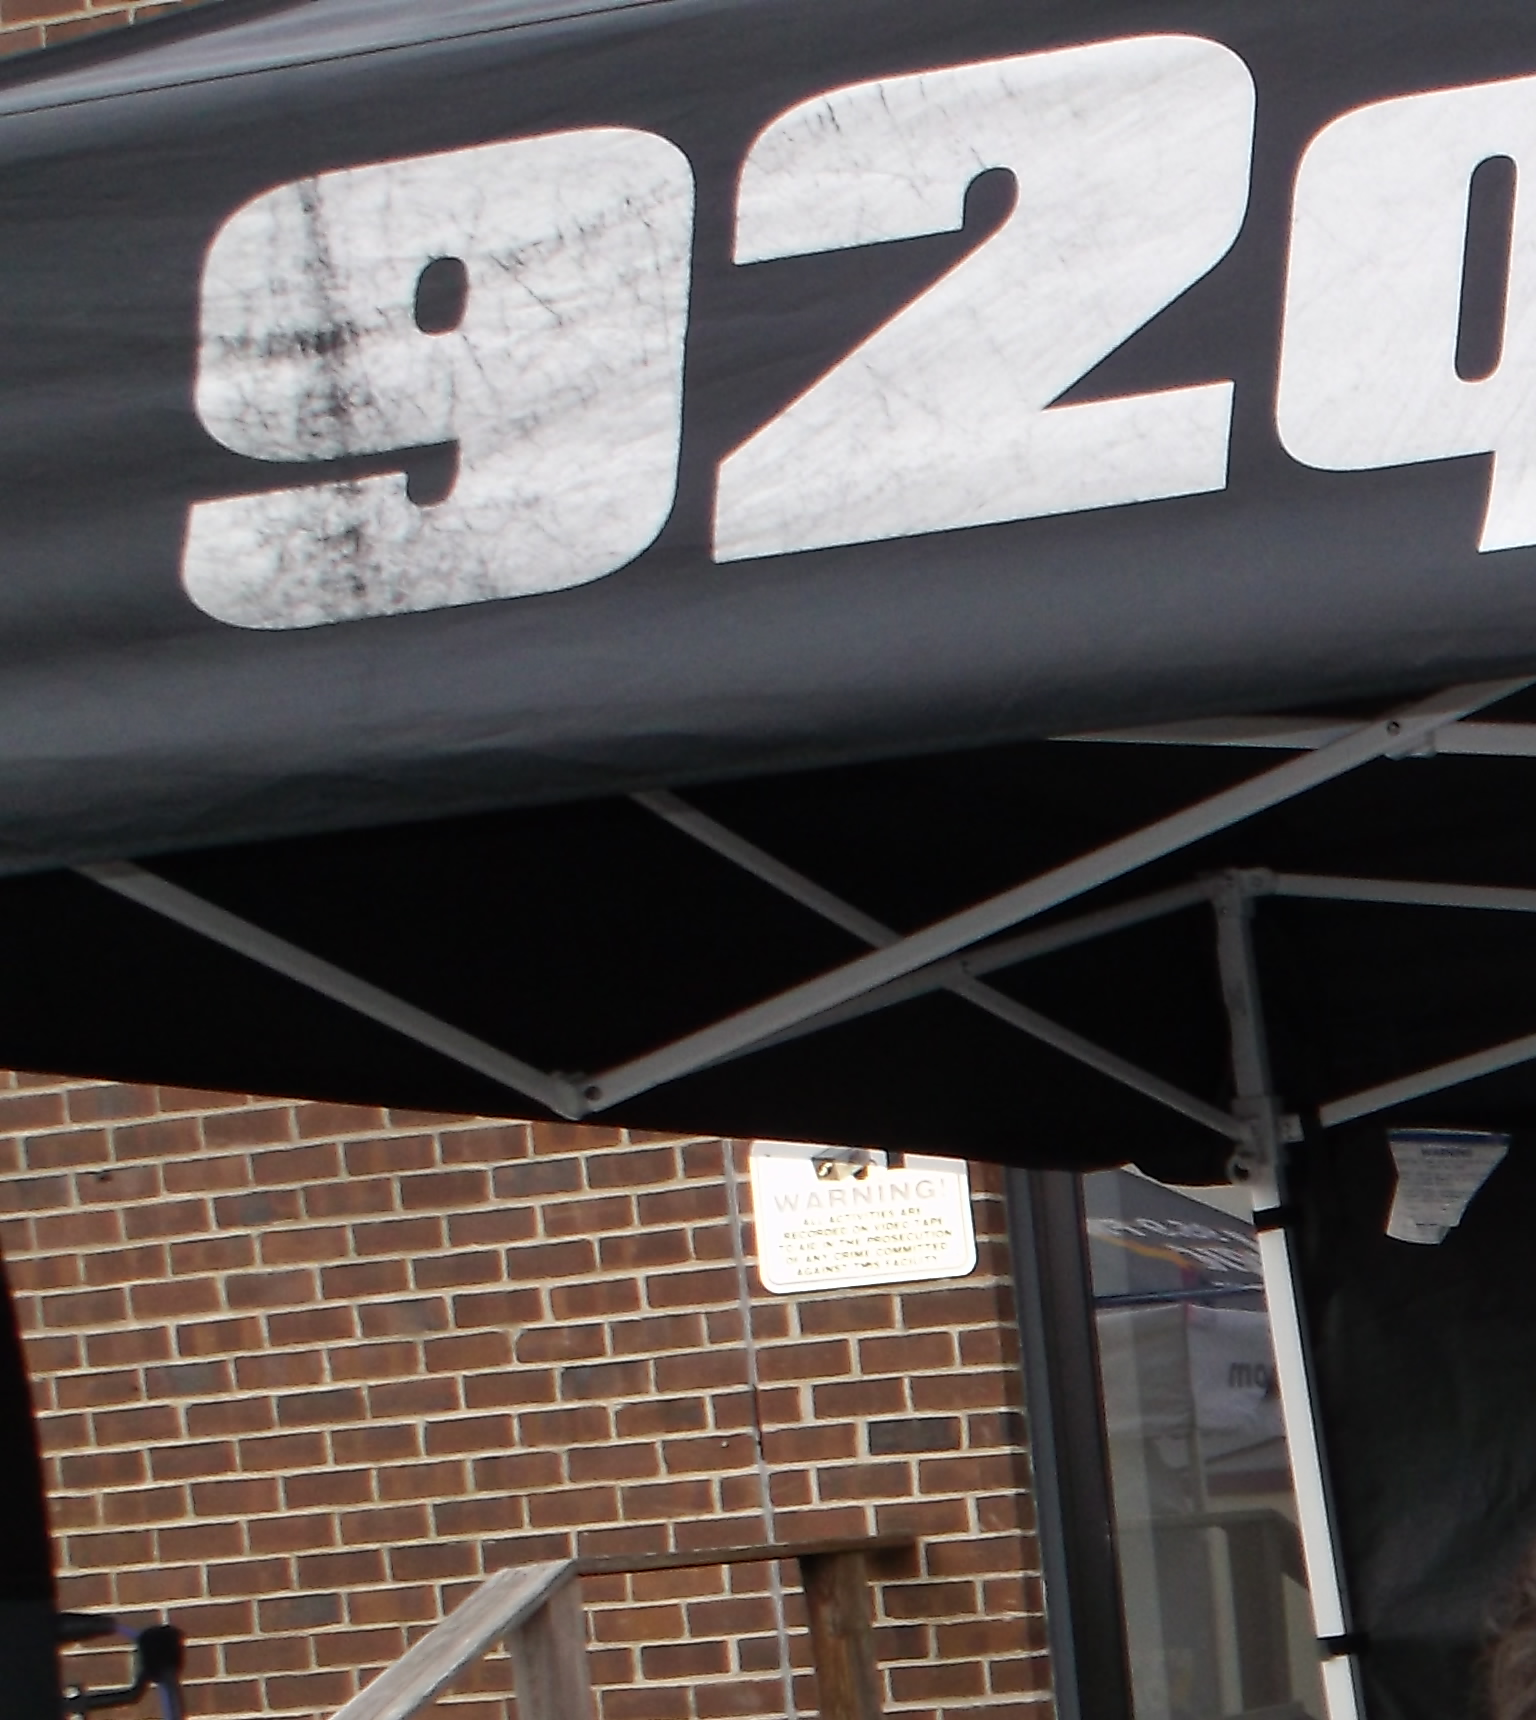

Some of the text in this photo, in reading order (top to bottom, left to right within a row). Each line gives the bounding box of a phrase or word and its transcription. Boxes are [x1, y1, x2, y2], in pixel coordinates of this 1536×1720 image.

[773, 1177, 946, 1213] WARNING!
[783, 1226, 848, 1240] RECORDED
[874, 1221, 909, 1231] VIDEO
[866, 1229, 953, 1244] PROSECUTION
[875, 1241, 948, 1257] COMMITTED
